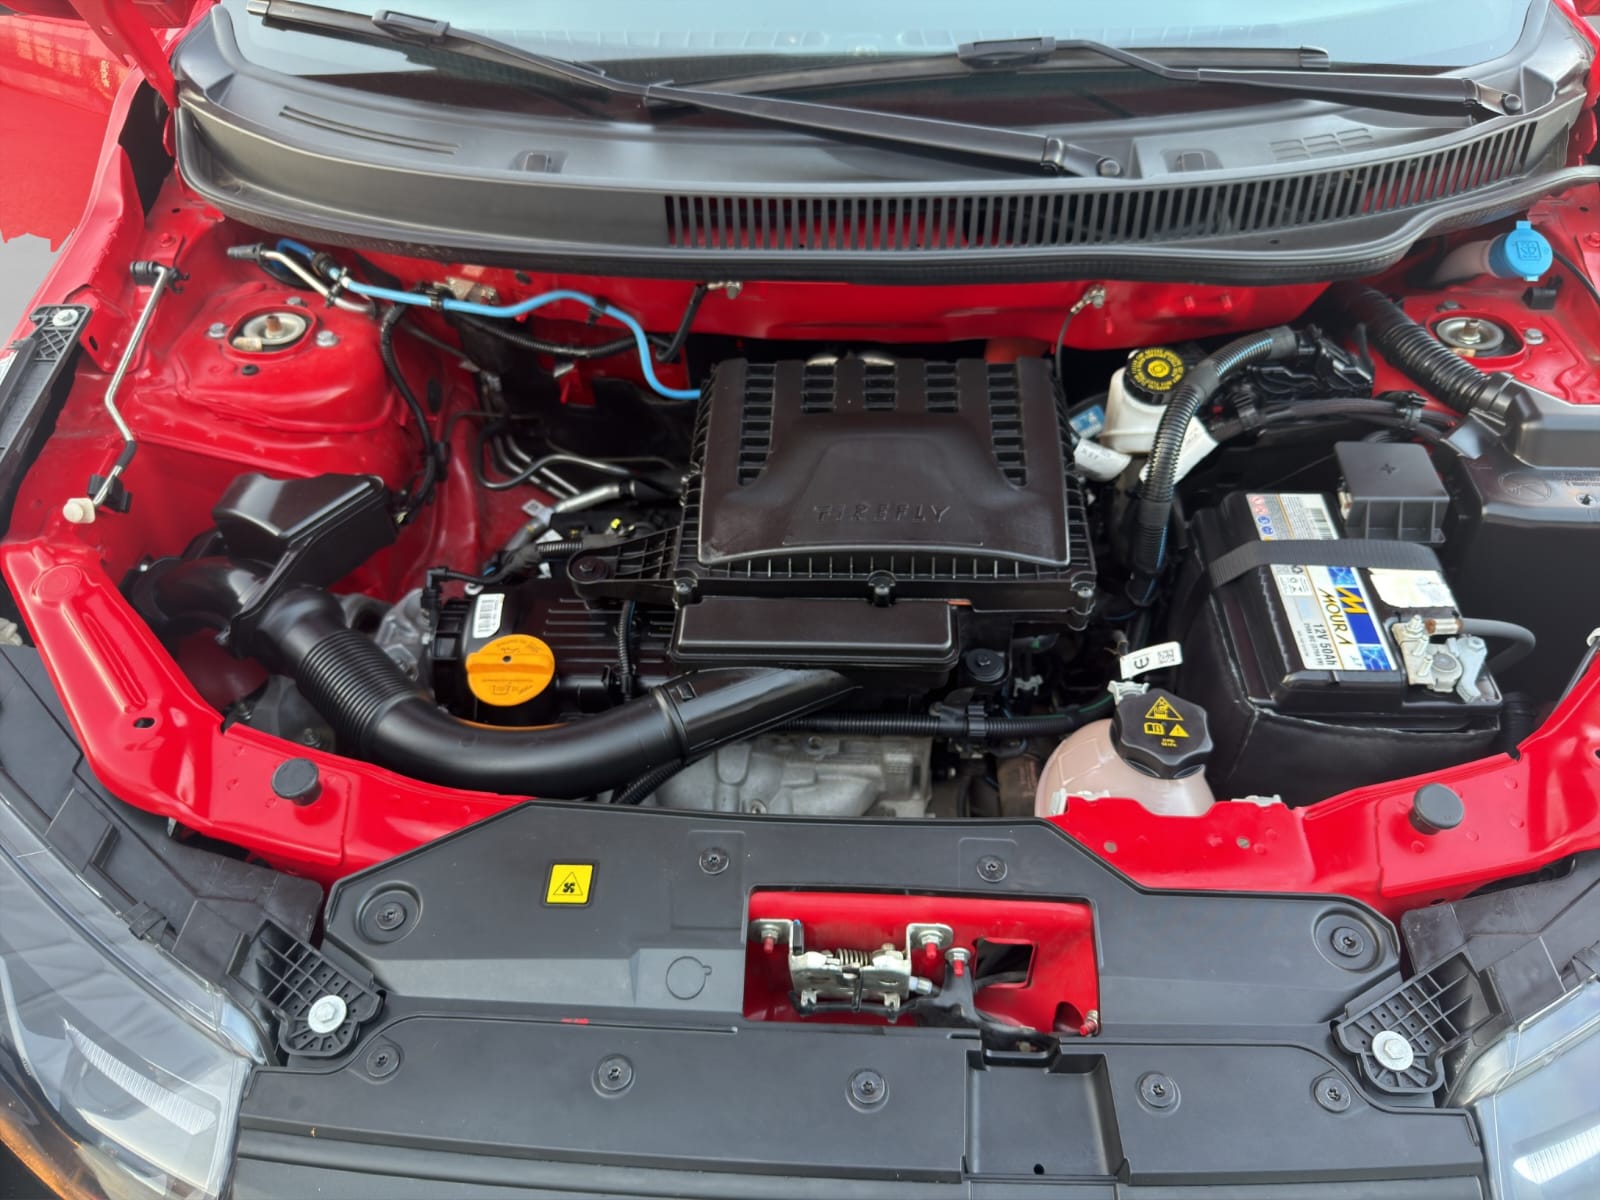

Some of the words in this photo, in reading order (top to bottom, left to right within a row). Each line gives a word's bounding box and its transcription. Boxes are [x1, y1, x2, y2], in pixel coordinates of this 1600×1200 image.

[813, 502, 951, 522] FIREFLY
[1318, 587, 1354, 645] MOURA
[1313, 623, 1329, 641] 12V
[1320, 642, 1337, 666] 50Ah
